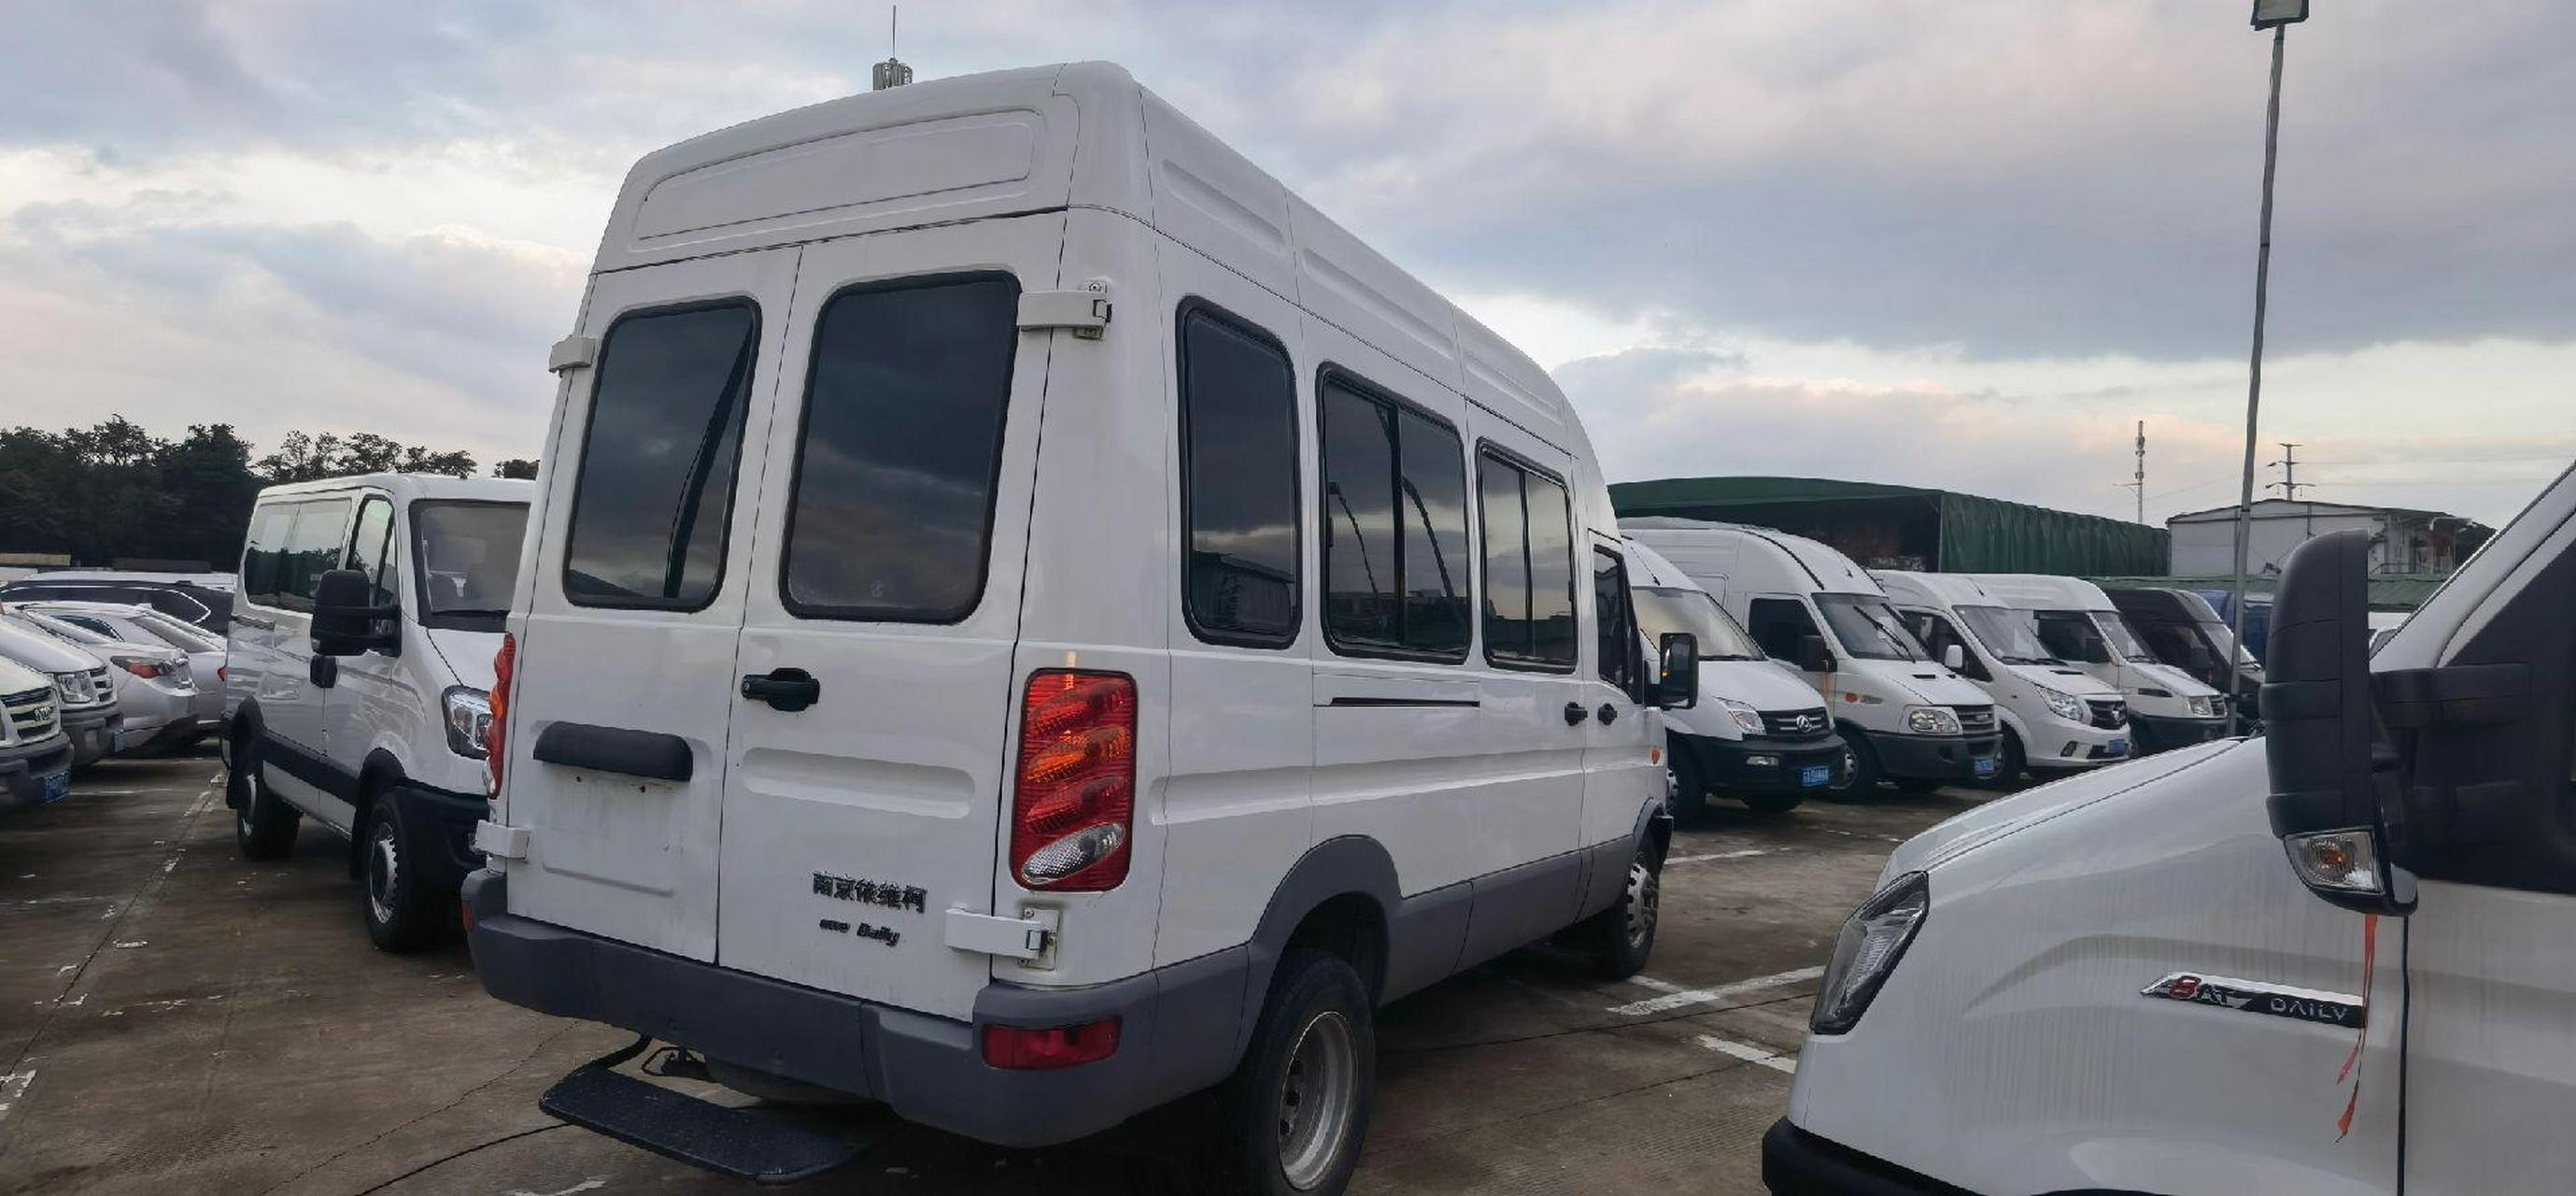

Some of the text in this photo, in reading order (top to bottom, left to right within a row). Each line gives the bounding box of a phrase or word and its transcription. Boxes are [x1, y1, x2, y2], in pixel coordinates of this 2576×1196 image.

[813, 872, 927, 913] 南京依维柯
[2270, 997, 2348, 1020] DAILY
